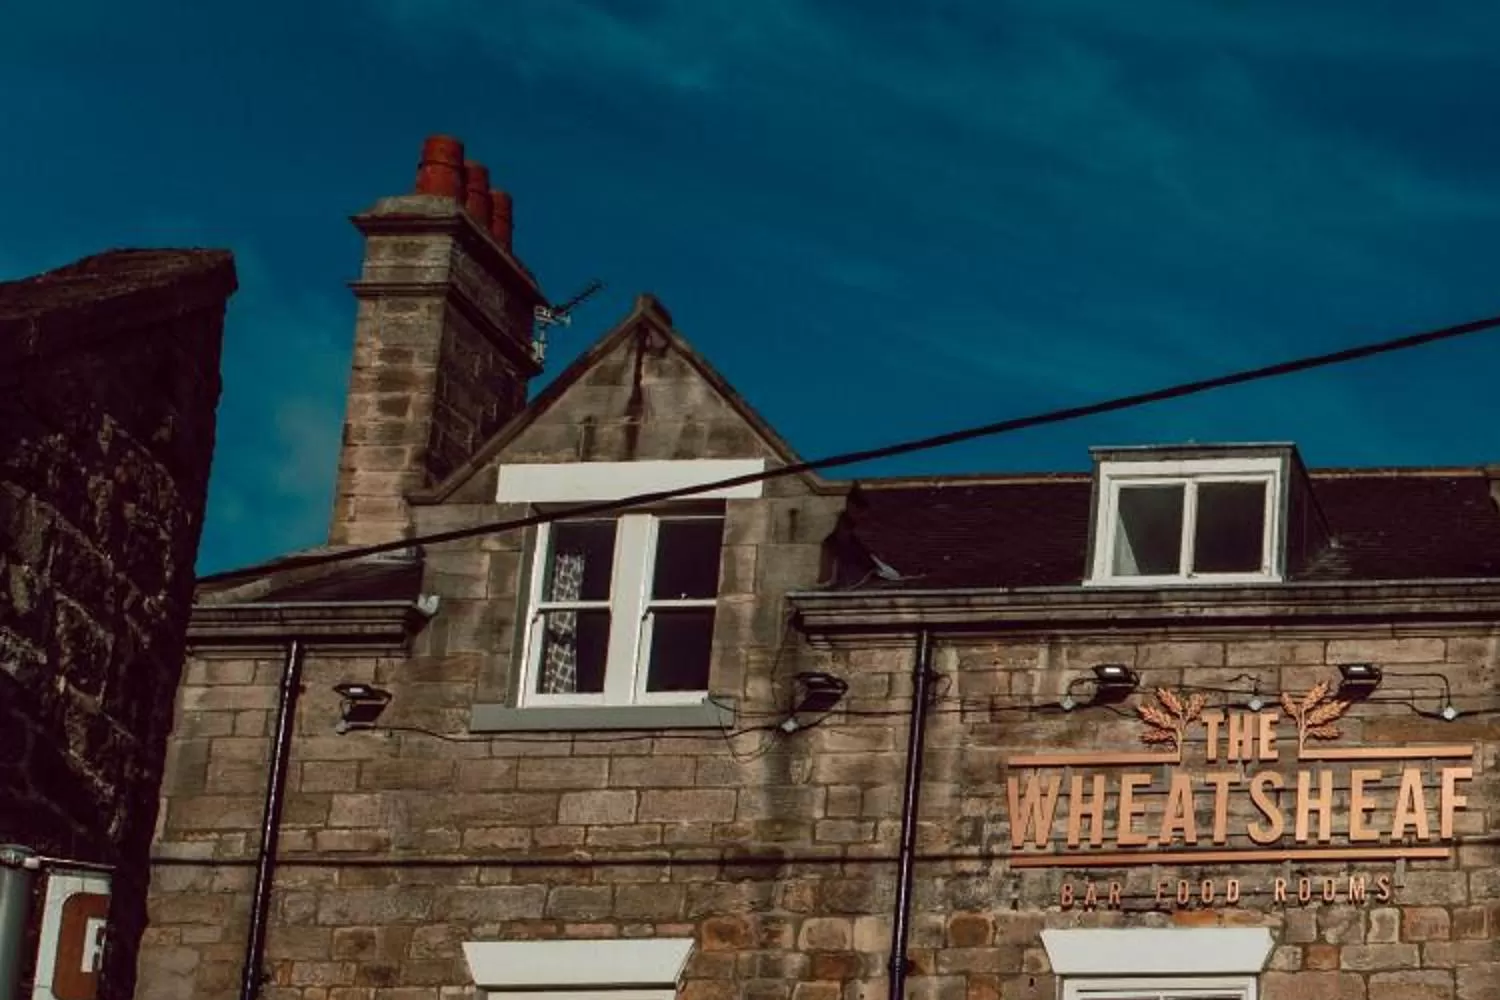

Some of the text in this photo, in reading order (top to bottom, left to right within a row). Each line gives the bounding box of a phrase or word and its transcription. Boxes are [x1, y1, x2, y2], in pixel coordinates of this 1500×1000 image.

[1201, 713, 1281, 762] THE
[1006, 767, 1474, 847] WHEATSHEAF
[1060, 875, 1391, 908] BAR FOOD ROOMS
